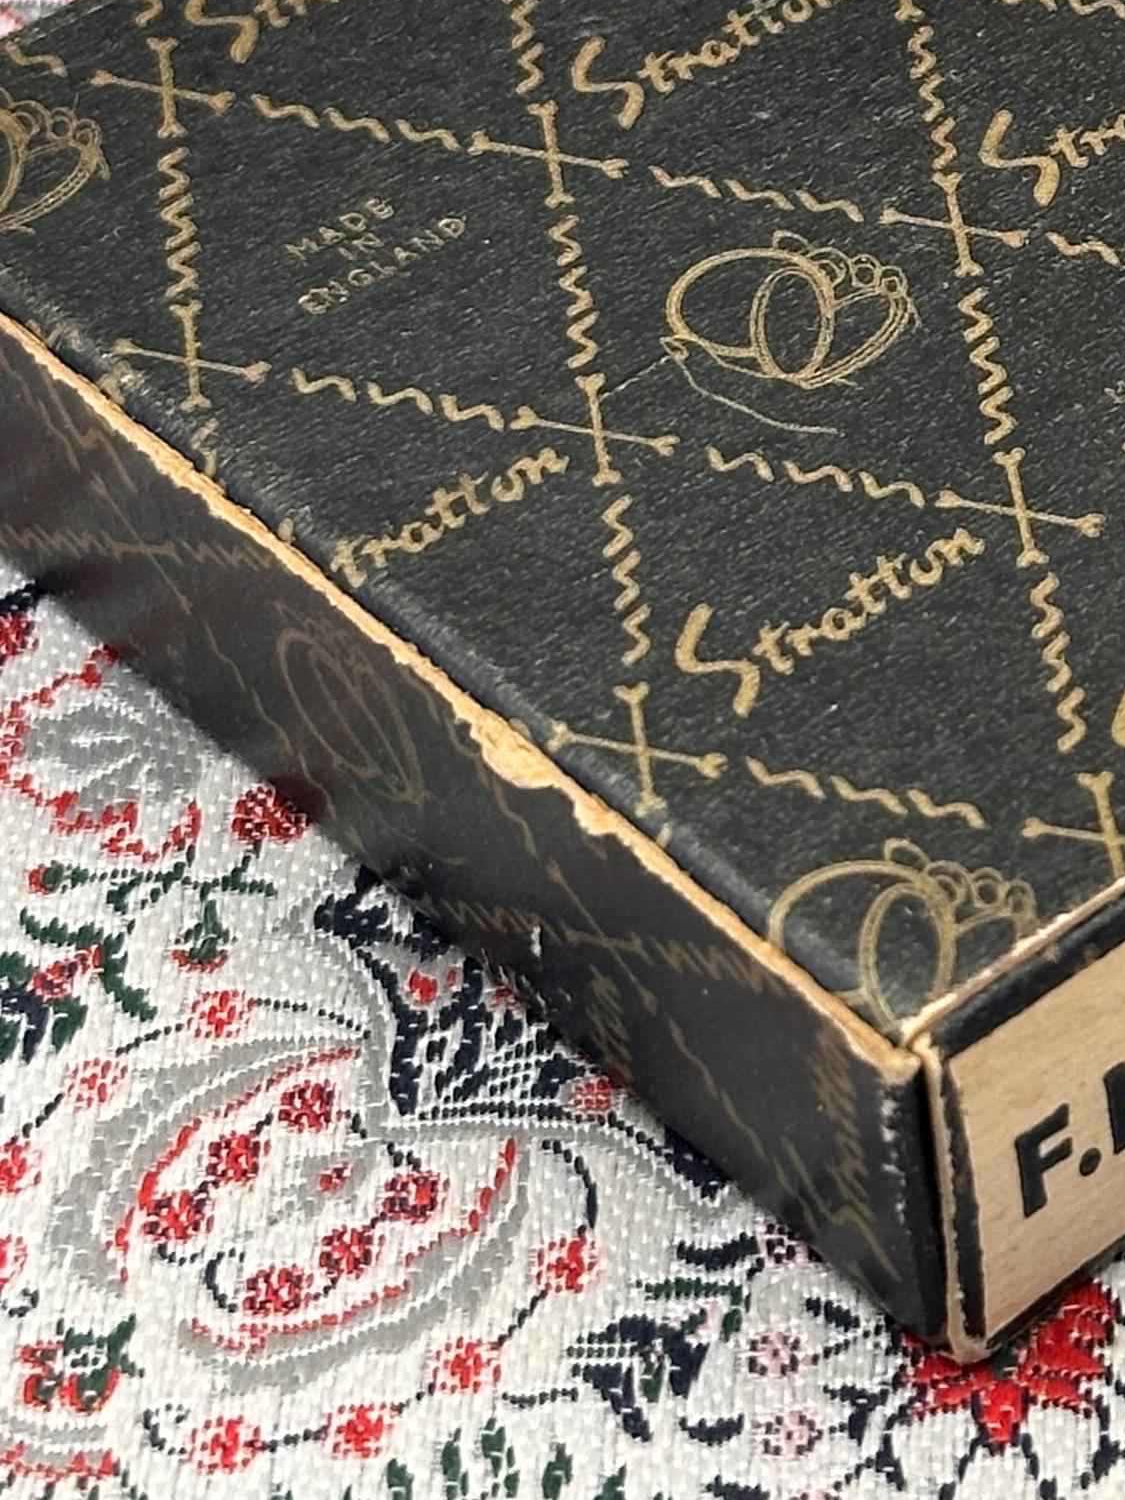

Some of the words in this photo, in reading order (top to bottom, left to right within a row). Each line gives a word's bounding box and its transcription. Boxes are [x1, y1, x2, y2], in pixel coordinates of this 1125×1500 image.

[285, 197, 395, 263] MADE
[298, 216, 467, 315] ENGLAND
[339, 232, 385, 261] IN
[278, 446, 571, 588] tratton
[674, 526, 985, 718] Stratton
